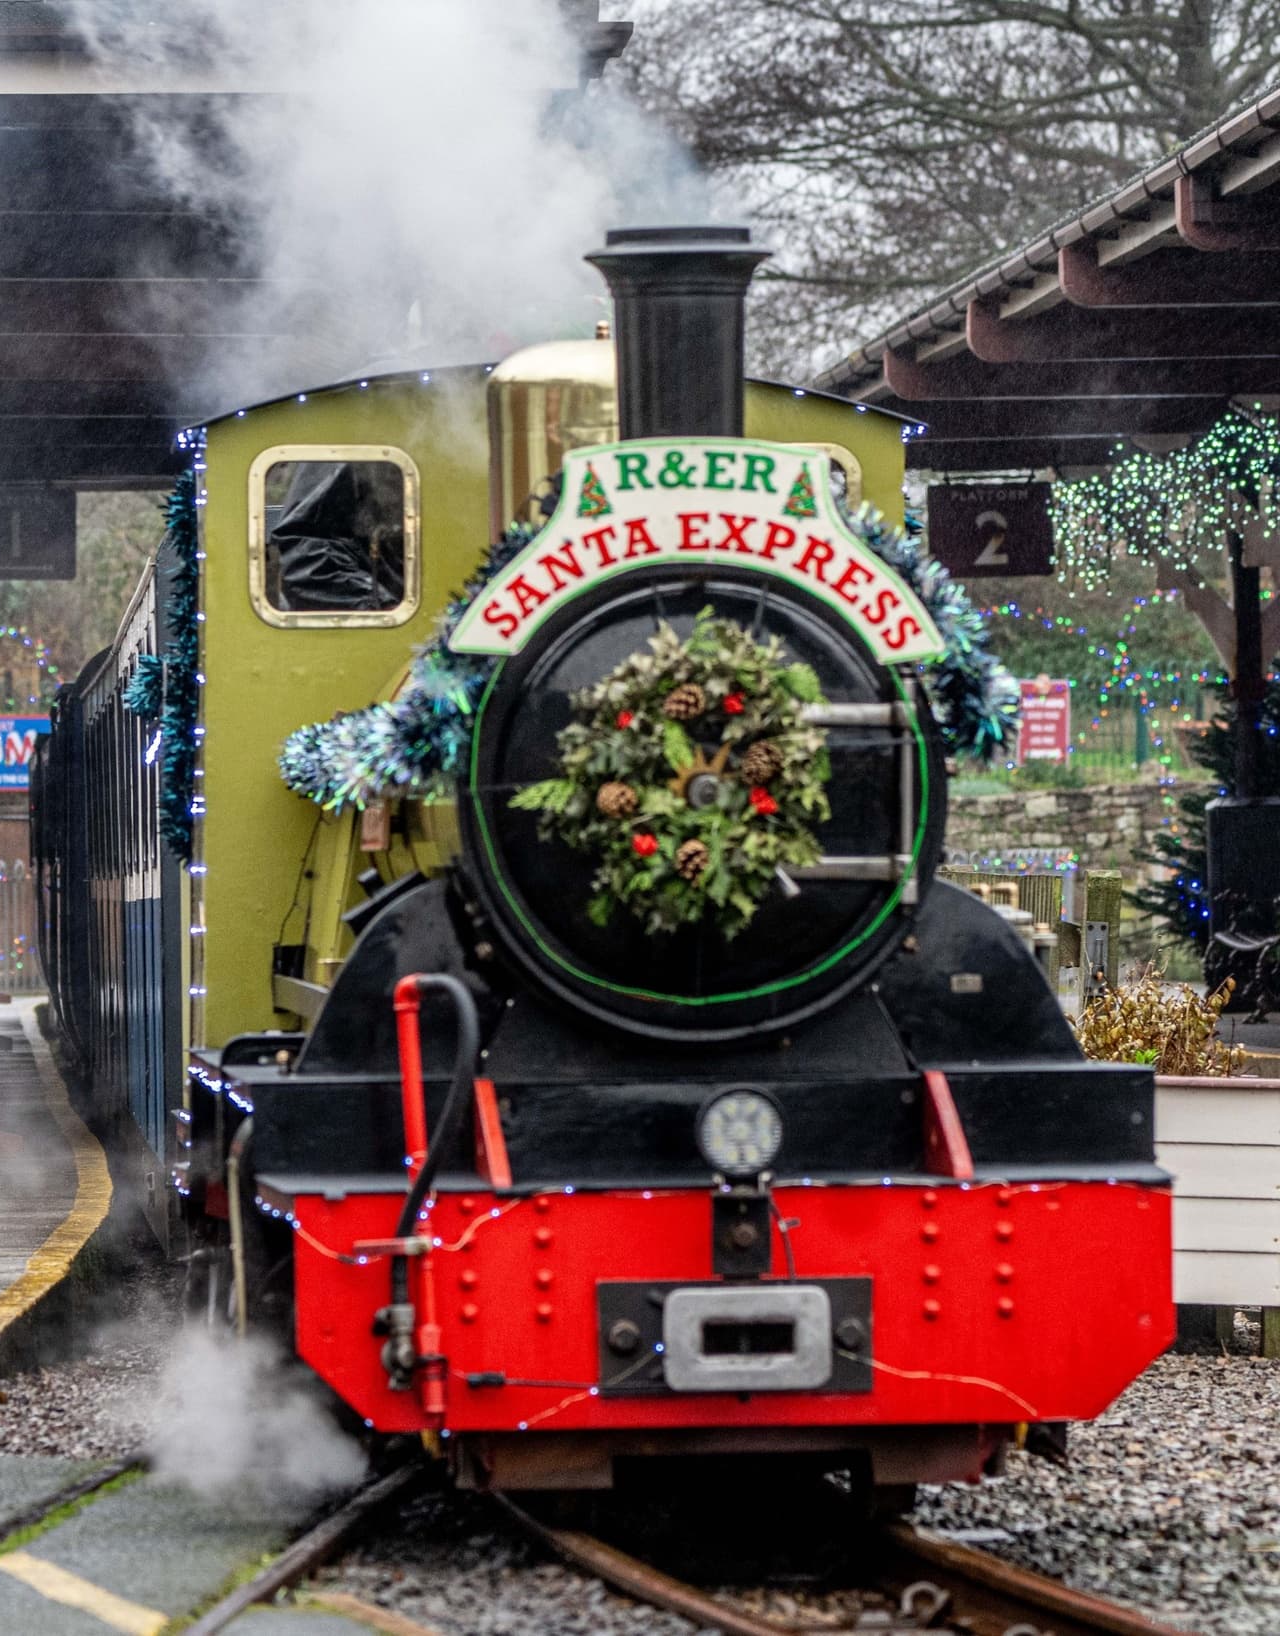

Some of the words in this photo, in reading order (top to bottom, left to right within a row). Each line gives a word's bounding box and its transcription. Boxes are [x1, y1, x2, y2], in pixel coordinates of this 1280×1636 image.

[614, 451, 778, 494] R&ER
[974, 510, 1009, 565] 2
[483, 518, 661, 639] SANTA
[677, 512, 922, 652] EXPRESS
